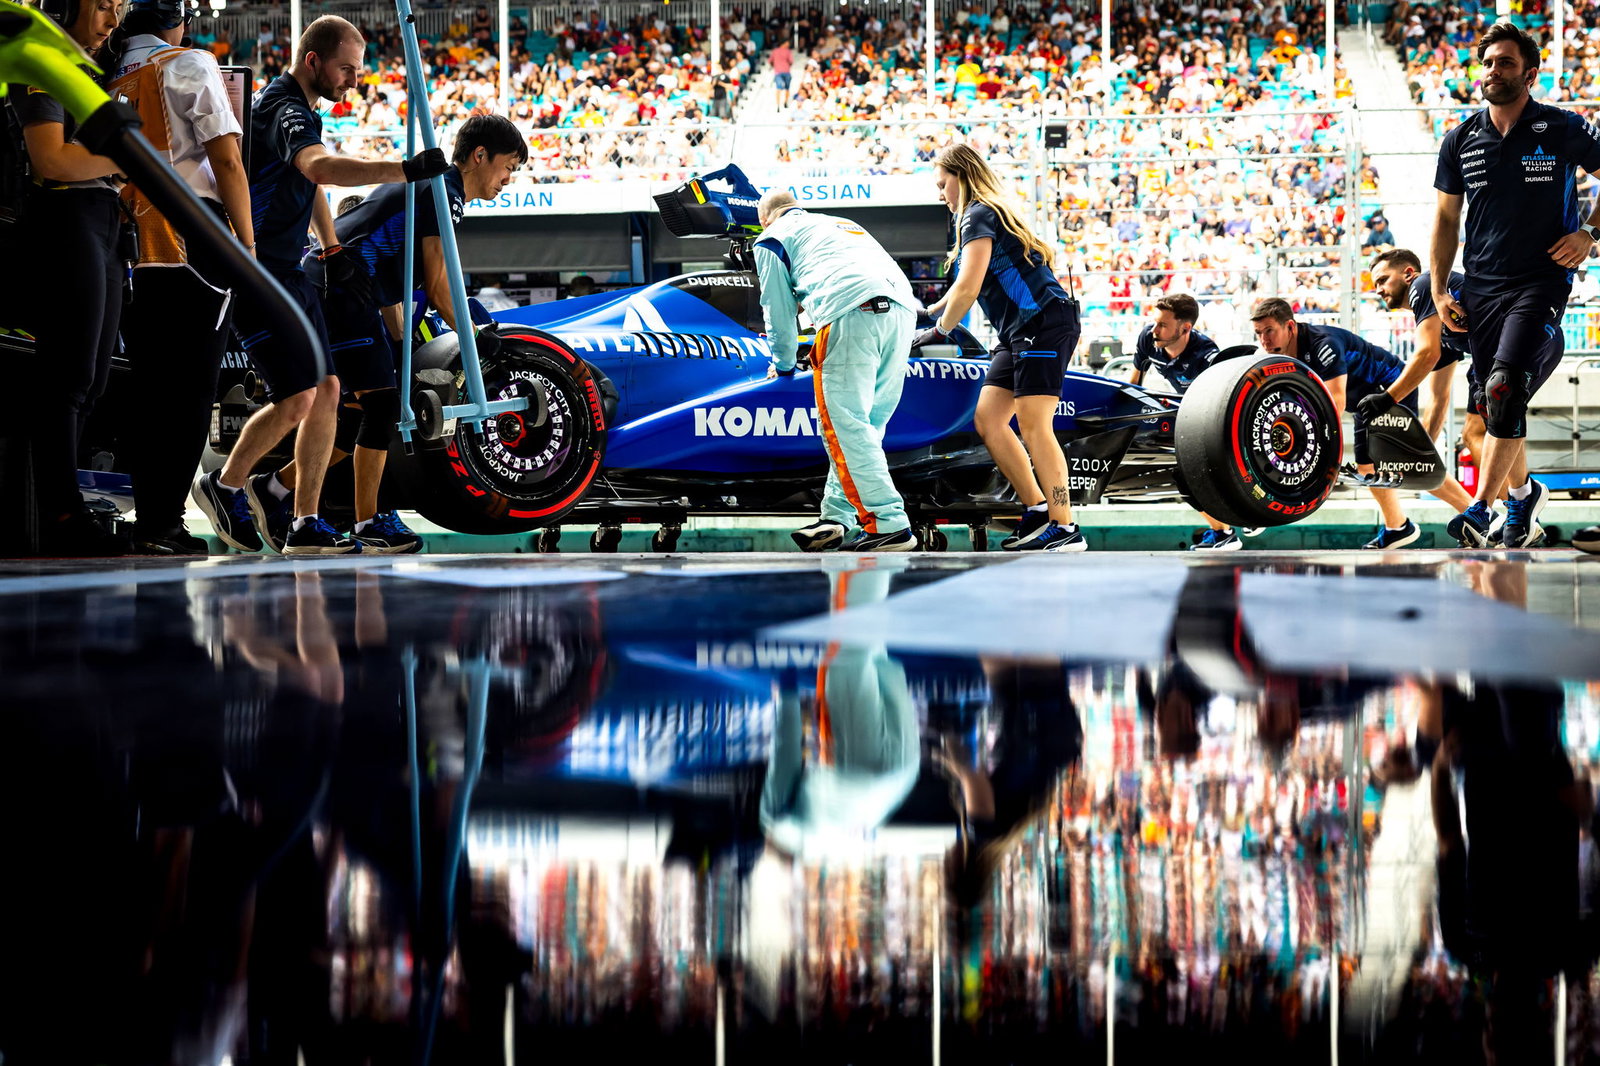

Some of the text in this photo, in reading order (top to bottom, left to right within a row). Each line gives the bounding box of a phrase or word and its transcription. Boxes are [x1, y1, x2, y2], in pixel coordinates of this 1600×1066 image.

[462, 192, 553, 209] ASSIAN
[687, 276, 755, 288] DURACELL
[570, 333, 772, 359] ATLASSIAN
[509, 371, 573, 419] JACKPOT CITY
[1252, 391, 1281, 452] JACKPOT CITY
[480, 445, 523, 483] JACKPOT
[1070, 458, 1112, 472] ZOOX
[1280, 442, 1322, 485] JACKPOT CITY
[1378, 461, 1436, 472] JACKPOT CITY
[1267, 497, 1319, 515] ZERO
